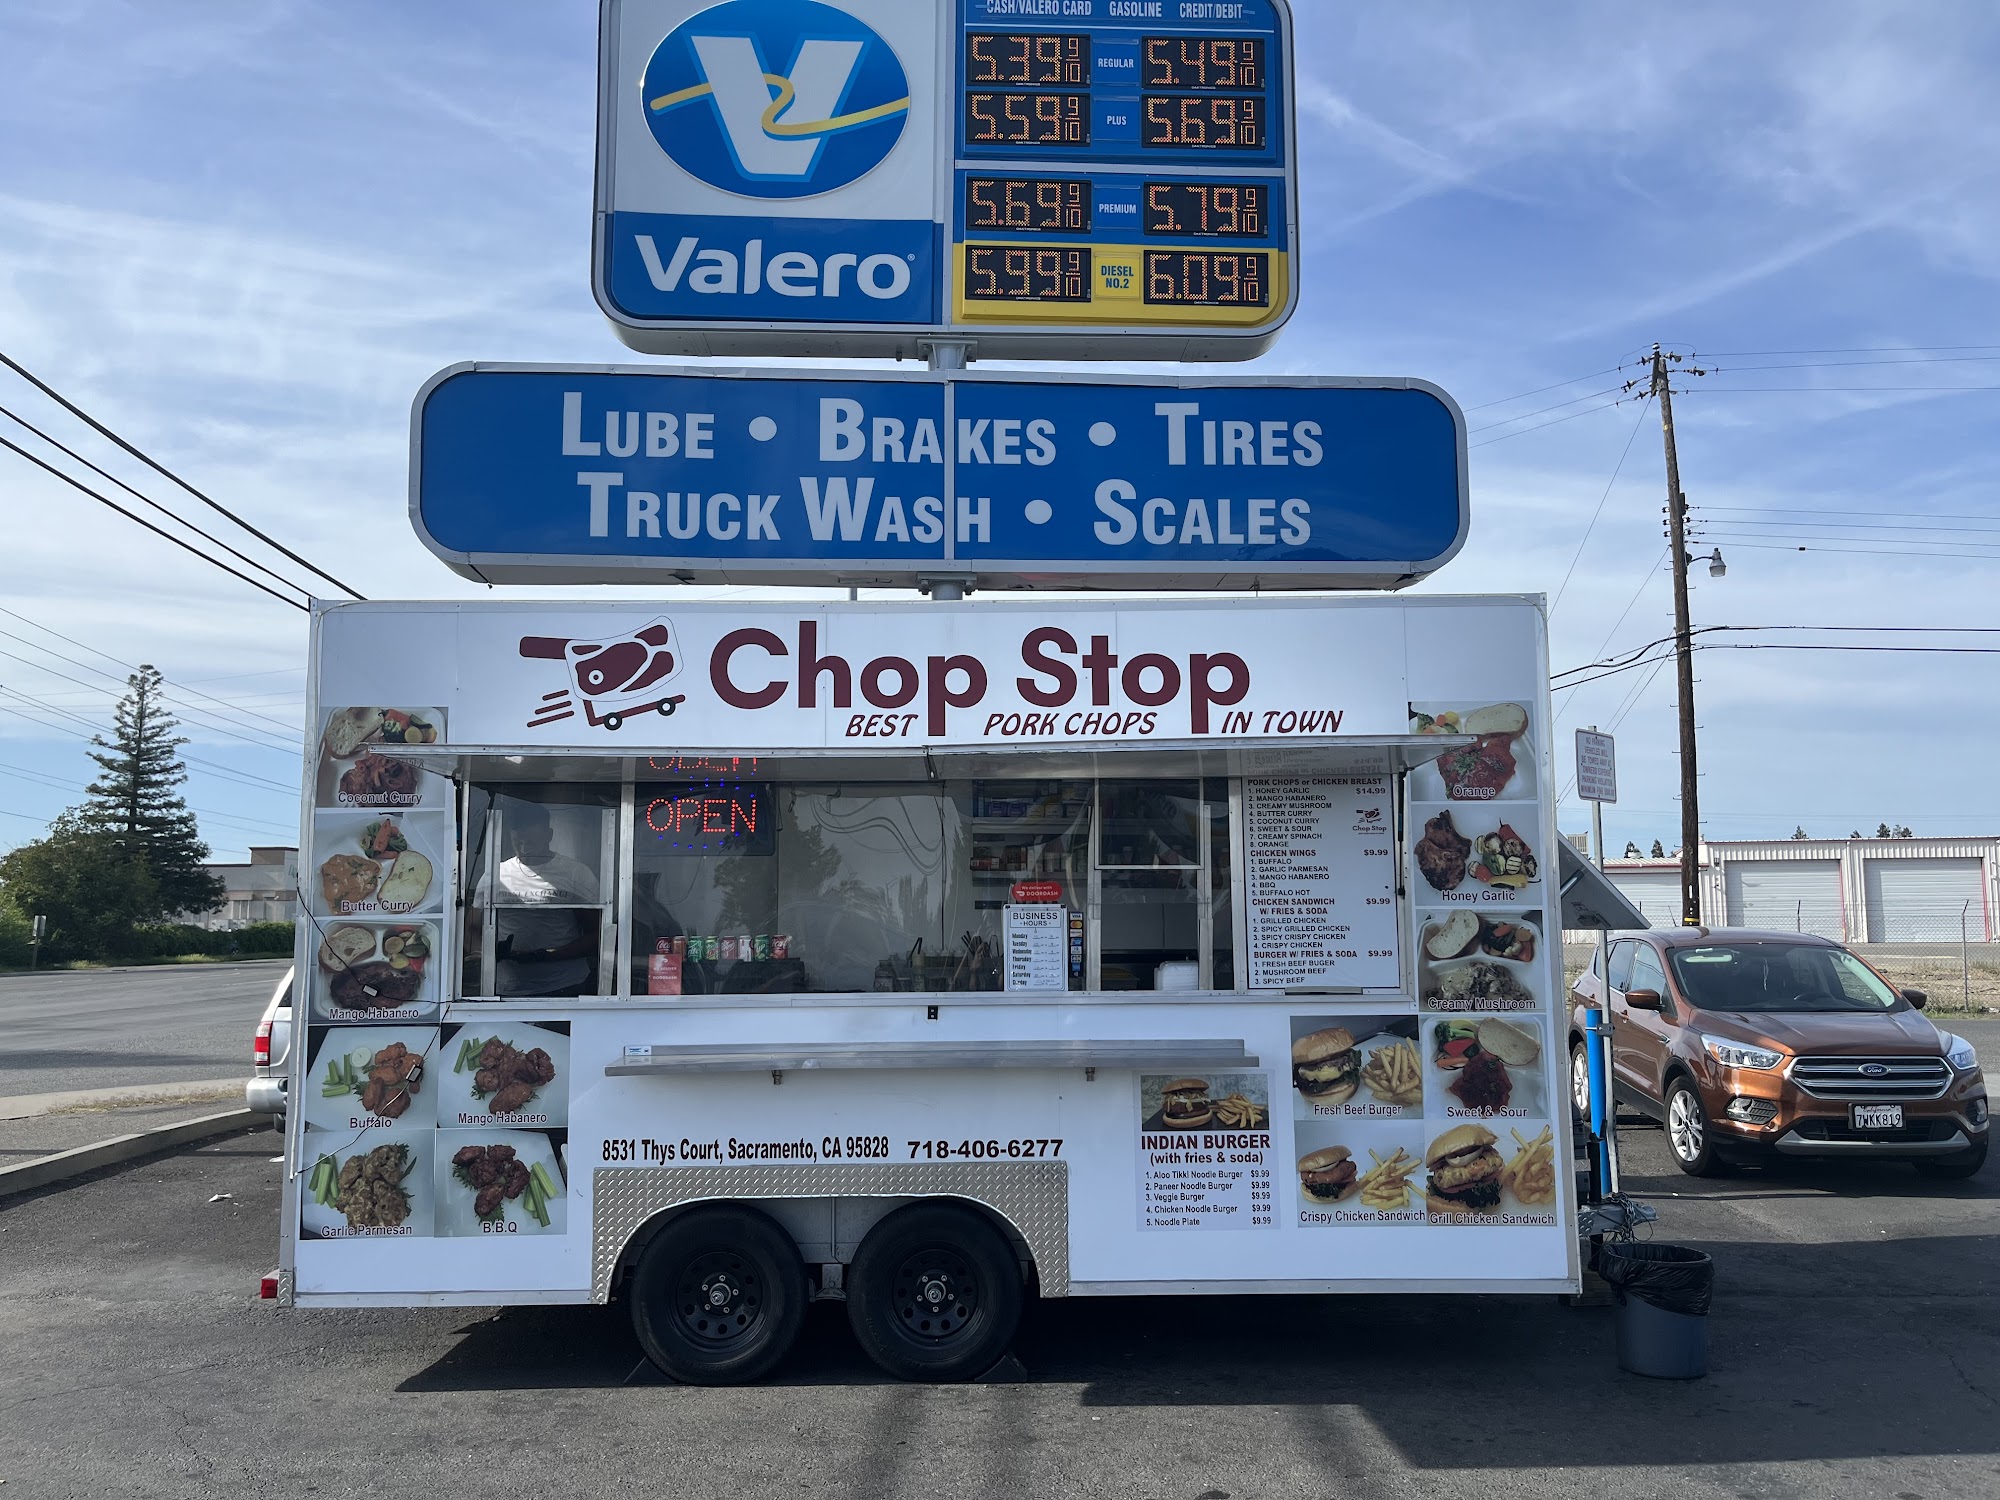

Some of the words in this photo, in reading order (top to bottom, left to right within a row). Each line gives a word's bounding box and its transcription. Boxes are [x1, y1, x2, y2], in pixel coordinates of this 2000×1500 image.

[986, 0, 1059, 15] CASH/VALERO
[1063, 1, 1092, 15] CARD
[1109, 2, 1162, 18] GASOLINE
[1179, 3, 1242, 19] CREDIT/DEBIT
[1098, 58, 1134, 69] REGULAR
[1107, 116, 1127, 126] PLUS
[1099, 204, 1137, 214] PREMIUM
[634, 234, 911, 299] Valero
[1101, 265, 1134, 277] DIESEL
[1106, 278, 1130, 289] NO.2
[562, 391, 715, 460] LUBE
[819, 397, 1057, 467] BRAKES
[1154, 402, 1324, 467] TIRES
[576, 471, 782, 541] TRUCK
[799, 476, 991, 544] WASH
[1093, 478, 1312, 546] SCALES
[709, 620, 989, 737] Chop
[1016, 626, 1251, 735] Stop
[844, 714, 919, 737] BEST
[983, 712, 1060, 736] PORK
[1063, 711, 1159, 735] CHOPS
[1221, 711, 1254, 733] IN
[1262, 709, 1344, 733] TOWN
[1355, 787, 1386, 795] $14.99
[1453, 786, 1495, 800] Orange
[338, 792, 387, 804] Coconut
[389, 792, 423, 806] Curry
[647, 799, 756, 832] OPEN
[1442, 890, 1478, 905] Honey
[1481, 889, 1515, 901] Garlic
[341, 901, 378, 912] Butter
[381, 900, 414, 913] Curry
[1013, 912, 1058, 920] BUSINESS
[1428, 998, 1473, 1012] Creamy
[1475, 997, 1536, 1010] Mushroom
[329, 1008, 366, 1022] Mango
[367, 1007, 419, 1020] Habanero
[1314, 1104, 1343, 1116] Fresh
[1344, 1104, 1366, 1116] Beef
[1369, 1104, 1402, 1117] Burger
[1447, 1106, 1483, 1117] Sweet
[1484, 1106, 1493, 1117] &
[1500, 1106, 1527, 1117] Sour
[350, 1117, 392, 1128] Buffalo
[458, 1113, 493, 1126] Mango
[496, 1112, 547, 1124] Habanero
[1856, 1114, 1900, 1126] 7WKK819
[1141, 1135, 1198, 1150] INDIAN
[1204, 1135, 1270, 1149] BURGER
[602, 1139, 636, 1161] 8531
[641, 1139, 675, 1166] Thys
[680, 1138, 723, 1165] Court,
[727, 1136, 818, 1164] Sacramento,
[822, 1136, 842, 1159] CA
[846, 1136, 889, 1158] 95828
[907, 1139, 1064, 1159] 718-406-6277
[1150, 1152, 1181, 1166] (with
[1185, 1152, 1212, 1163] fries
[1217, 1153, 1225, 1163] &
[1230, 1151, 1263, 1165] soda)
[1219, 1170, 1243, 1179] Burger
[1251, 1170, 1269, 1178] $9.99
[1181, 1182, 1206, 1190] Noodle
[1208, 1182, 1233, 1191] Burger
[1154, 1193, 1178, 1202] Veggie
[1180, 1193, 1204, 1201] Burger
[1251, 1192, 1270, 1200] $9.99
[1155, 1205, 1183, 1213] Chicken
[1186, 1205, 1211, 1213] Noodle
[1213, 1205, 1237, 1214] Burger
[1155, 1218, 1180, 1226] Noodle
[1252, 1217, 1271, 1225] $9.99
[1300, 1211, 1332, 1224] Crispy
[1335, 1210, 1375, 1222] Chicken
[1377, 1210, 1426, 1222] Sandwich
[1430, 1213, 1452, 1224] Grill
[1455, 1213, 1499, 1224] Chicken
[1502, 1213, 1554, 1224] Sandwich
[321, 1225, 356, 1237] Garlic
[357, 1225, 412, 1236] Parmesan
[483, 1222, 518, 1234] B.B.Q
